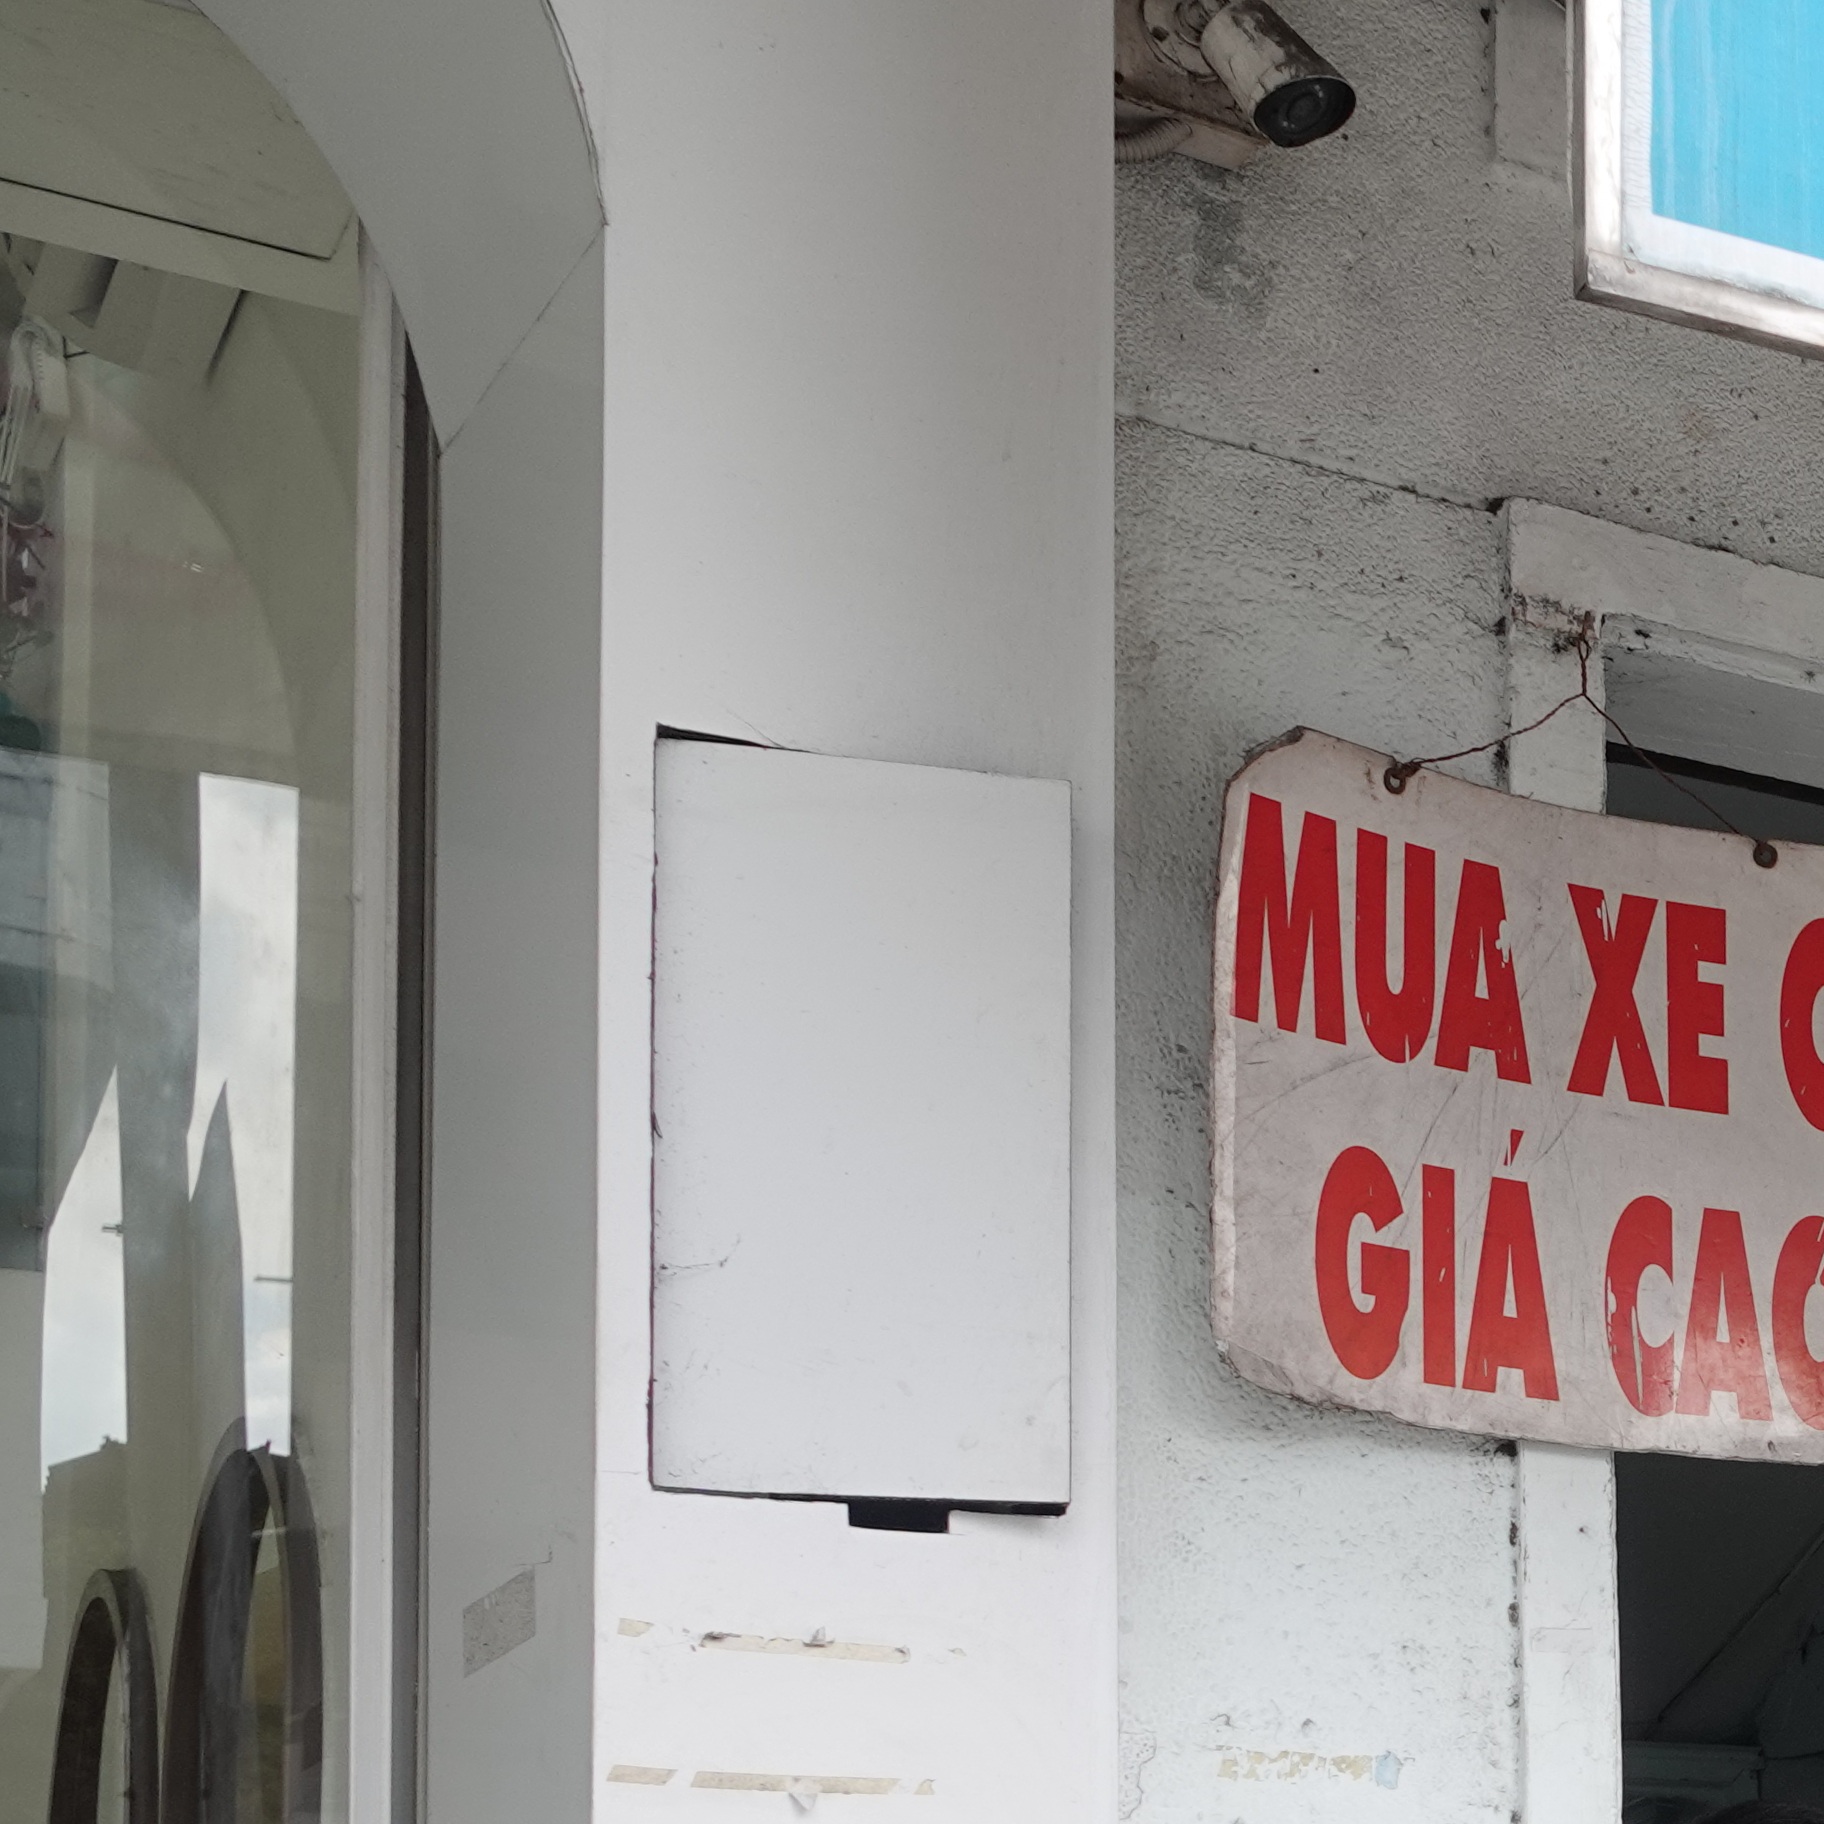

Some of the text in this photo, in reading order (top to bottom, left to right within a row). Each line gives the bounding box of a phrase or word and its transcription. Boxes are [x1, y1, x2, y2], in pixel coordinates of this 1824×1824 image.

[1231, 791, 1532, 1086] MUA
[1566, 882, 1730, 1116] XE
[1314, 1128, 1560, 1402] GIÁ
